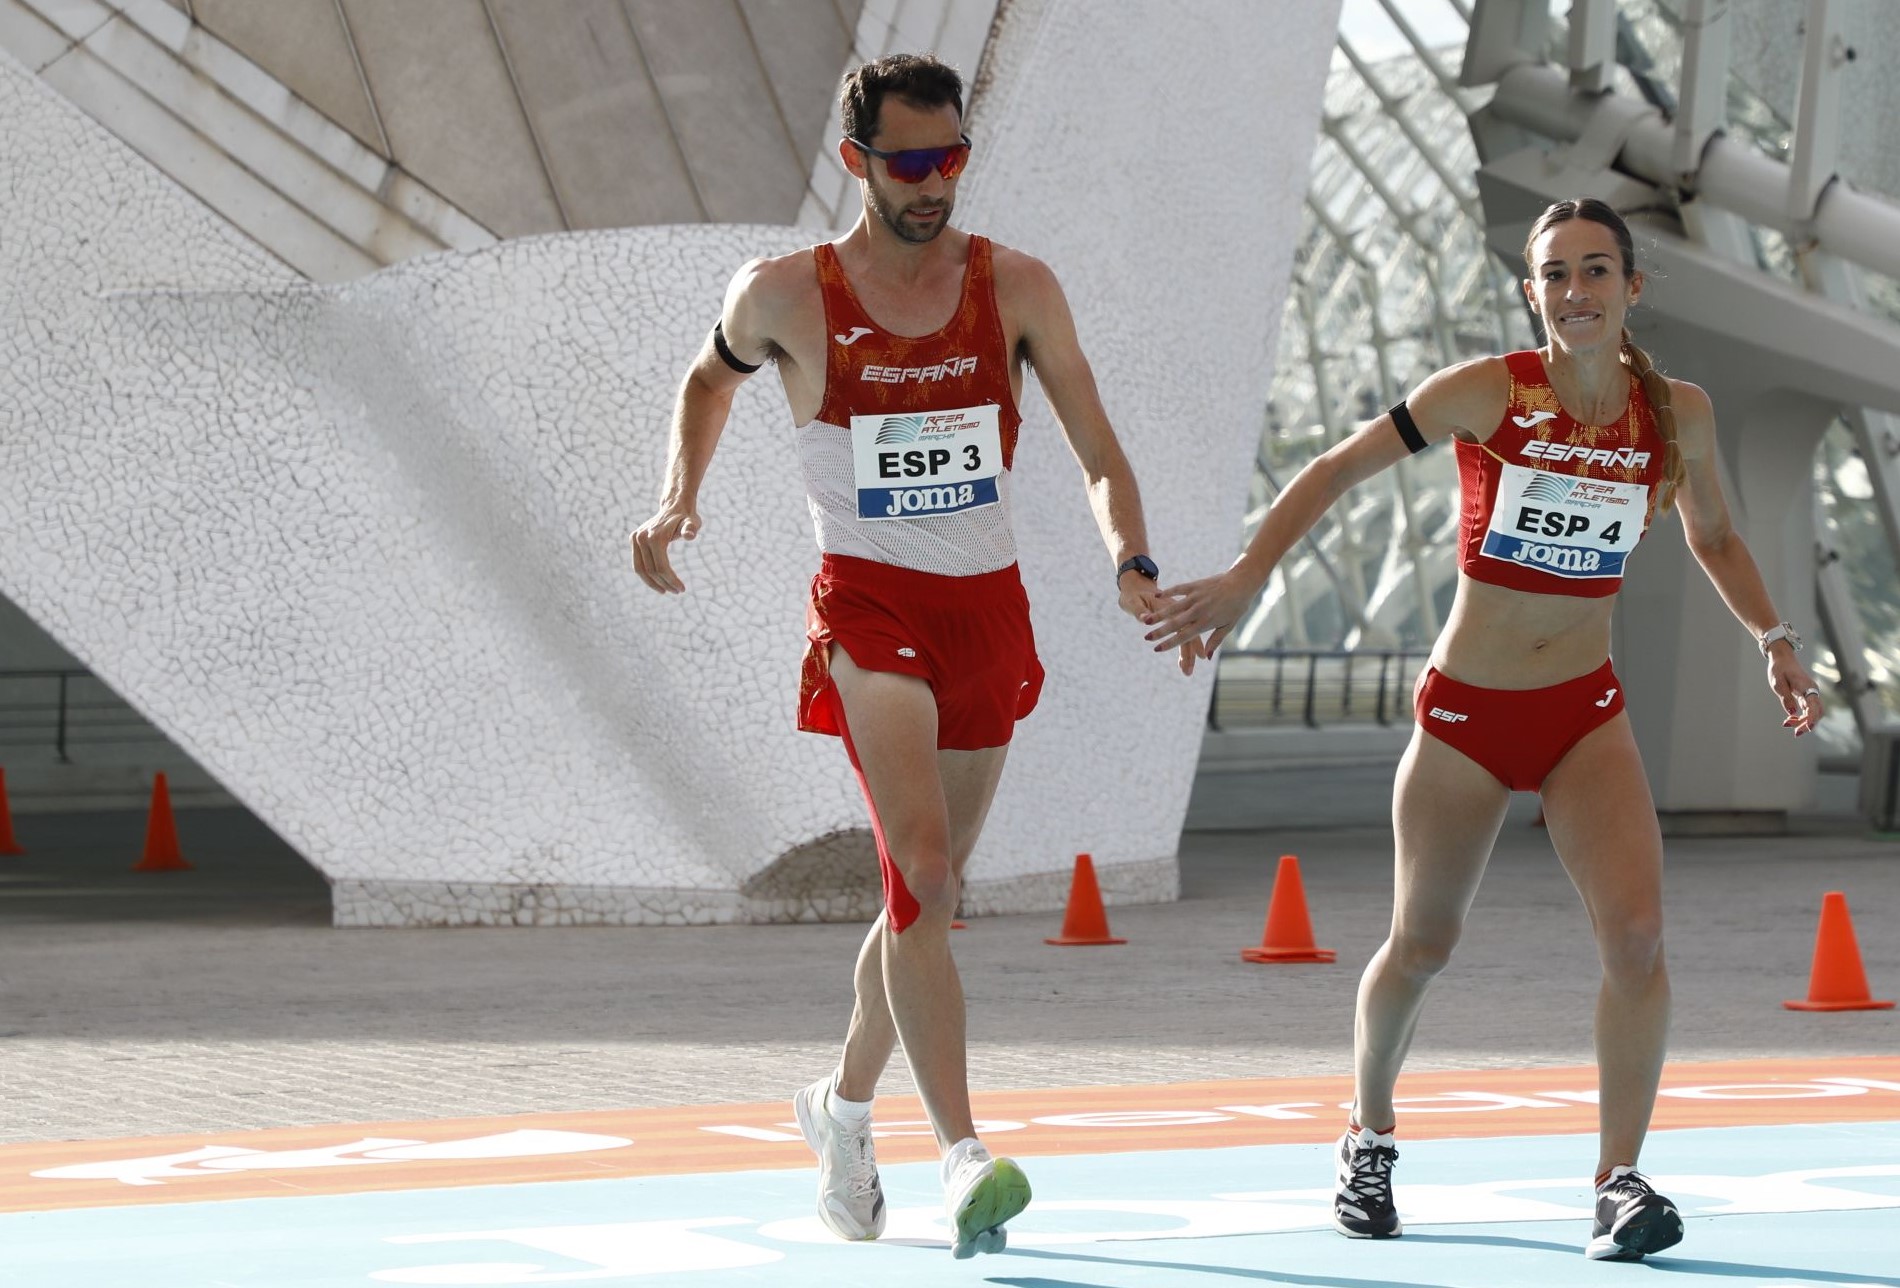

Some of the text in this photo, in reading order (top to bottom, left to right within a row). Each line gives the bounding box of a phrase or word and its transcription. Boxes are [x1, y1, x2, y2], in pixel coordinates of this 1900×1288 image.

[861, 357, 978, 383] ESPAÑA
[922, 421, 980, 433] ATLETISMO
[925, 413, 965, 425] RFEA
[878, 444, 981, 479] ESP 3
[1519, 439, 1652, 469] ESPAÑA
[1575, 482, 1616, 494] RFEA
[1569, 491, 1630, 505] ATLETISMO
[1515, 506, 1622, 545] ESP 4
[1429, 707, 1468, 723] ESP
